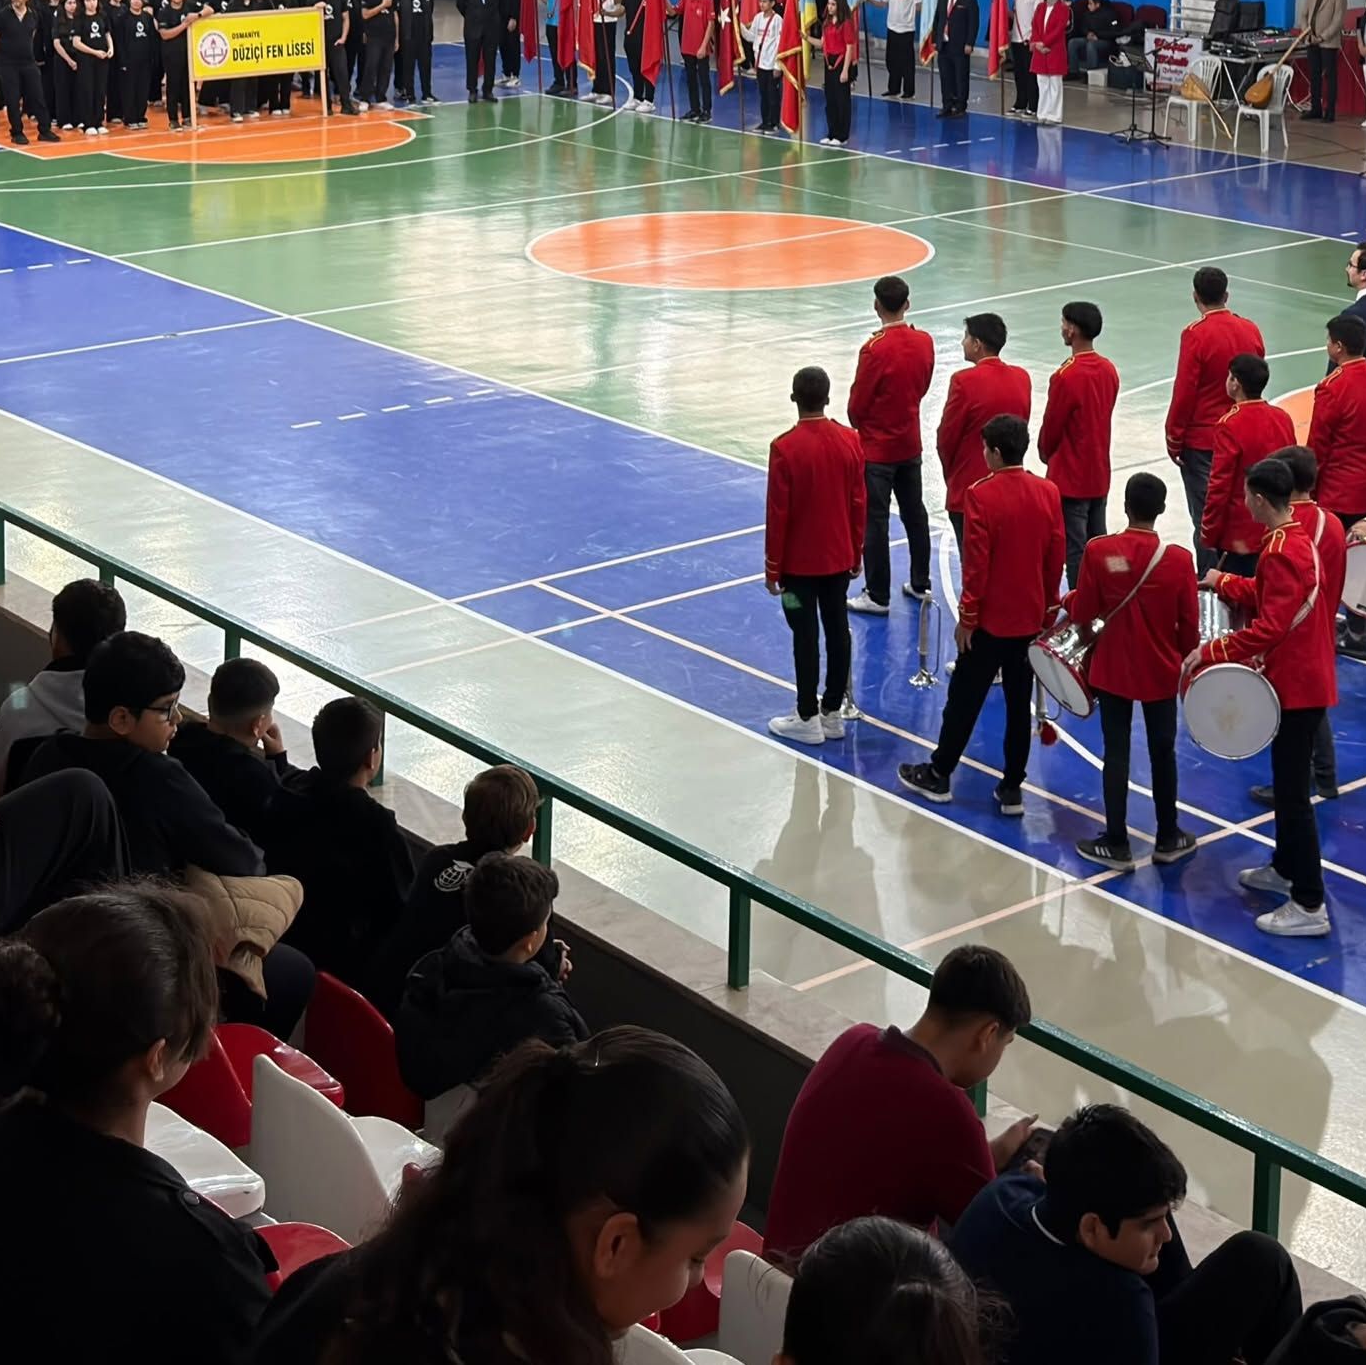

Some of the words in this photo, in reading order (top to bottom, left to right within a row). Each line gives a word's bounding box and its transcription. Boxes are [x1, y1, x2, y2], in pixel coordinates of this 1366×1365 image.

[231, 30, 260, 39] OSMANİYE
[232, 42, 263, 63] DÜZİÇİ
[266, 44, 283, 59] FEN
[287, 38, 314, 57] LİSESİ
